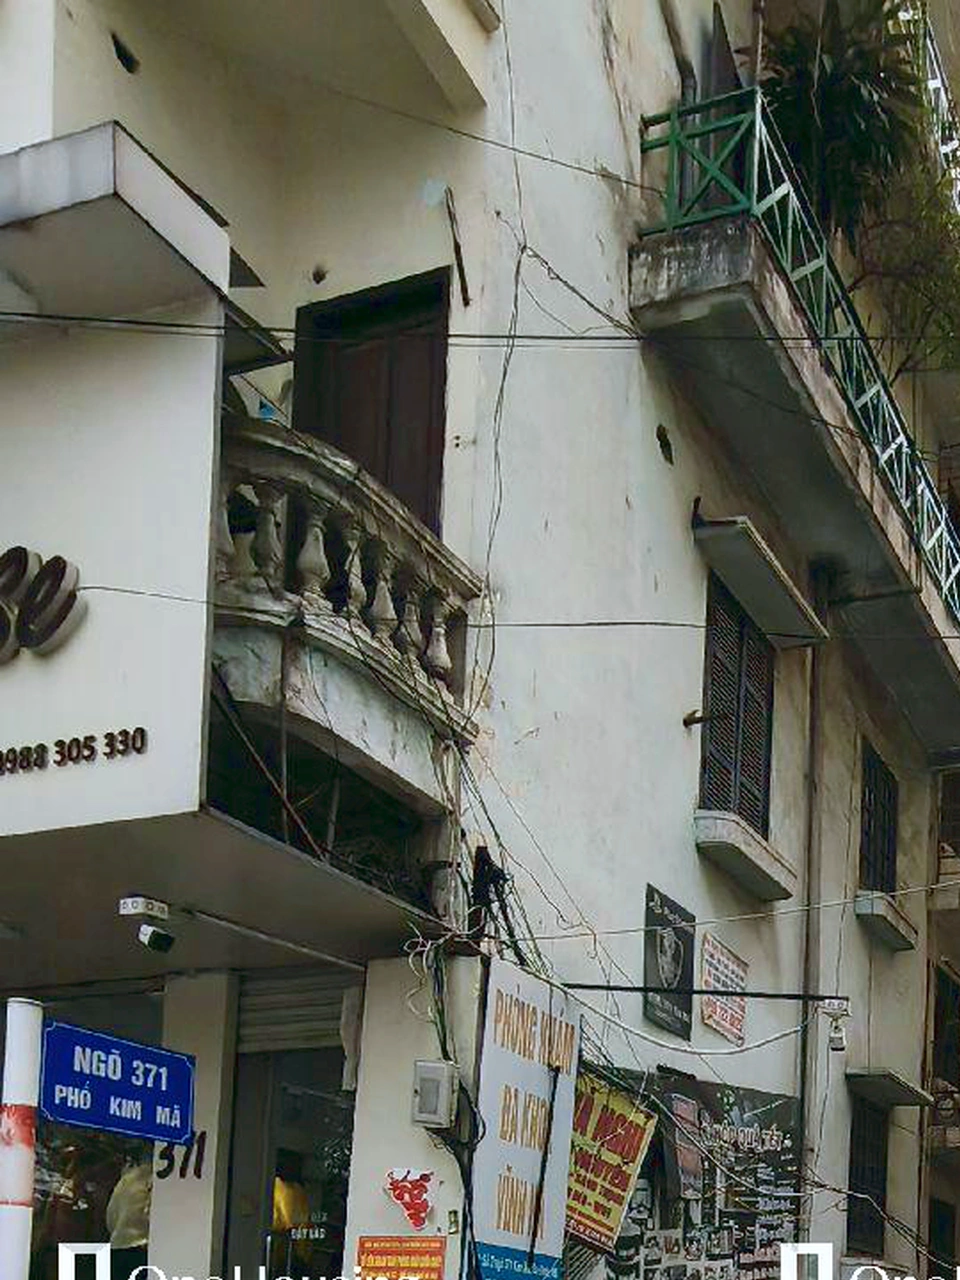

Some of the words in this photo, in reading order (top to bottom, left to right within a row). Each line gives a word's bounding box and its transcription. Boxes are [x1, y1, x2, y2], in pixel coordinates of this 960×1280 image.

[53, 735, 97, 767] 305
[103, 727, 148, 760] 330
[73, 1045, 122, 1081] NGÕ
[131, 1060, 169, 1092] 371
[54, 1080, 92, 1110] PHỐ
[109, 1095, 142, 1121] KIM
[156, 1104, 181, 1128] MÃ
